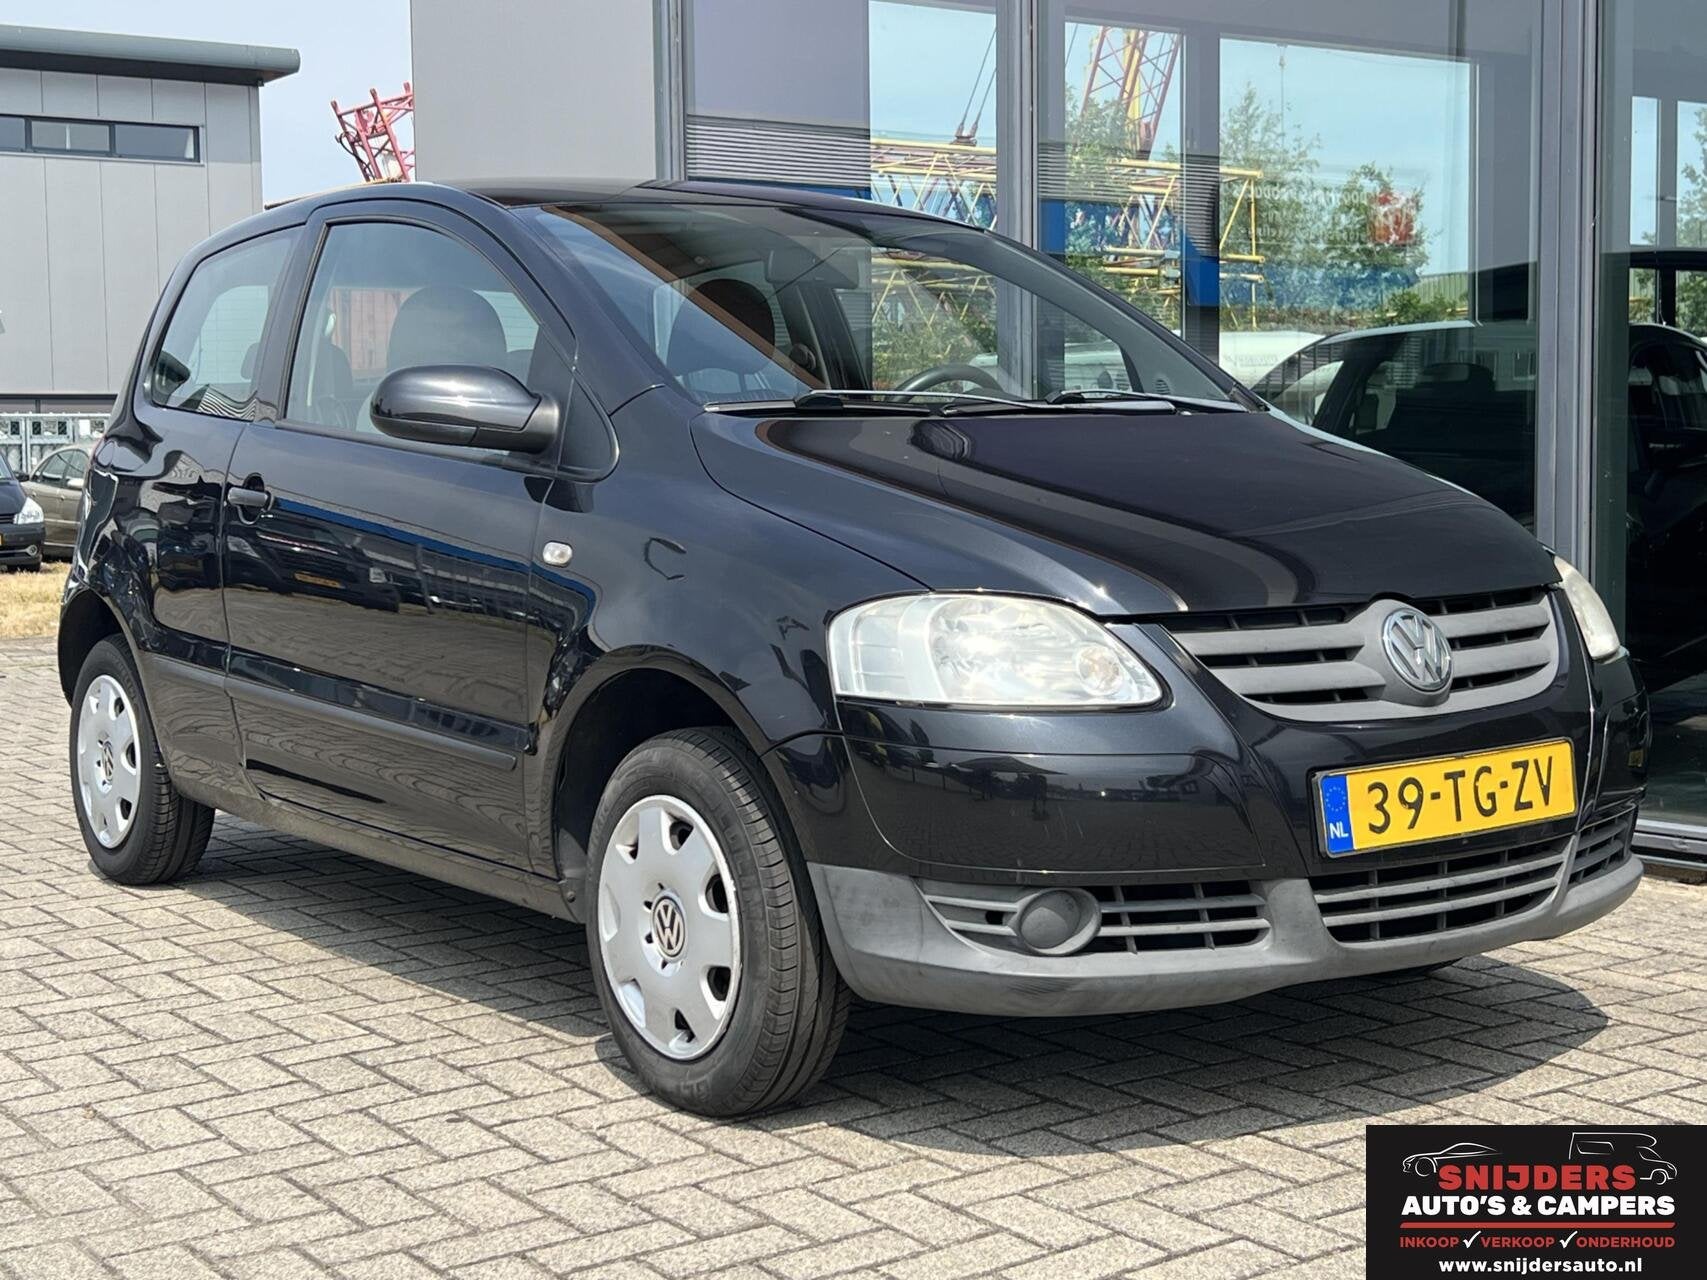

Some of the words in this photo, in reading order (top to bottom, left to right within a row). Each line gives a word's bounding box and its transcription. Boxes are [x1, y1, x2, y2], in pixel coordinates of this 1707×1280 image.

[1367, 756, 1553, 834] 39-TG-ZV
[1329, 823, 1349, 839] NL
[653, 897, 685, 956] VW
